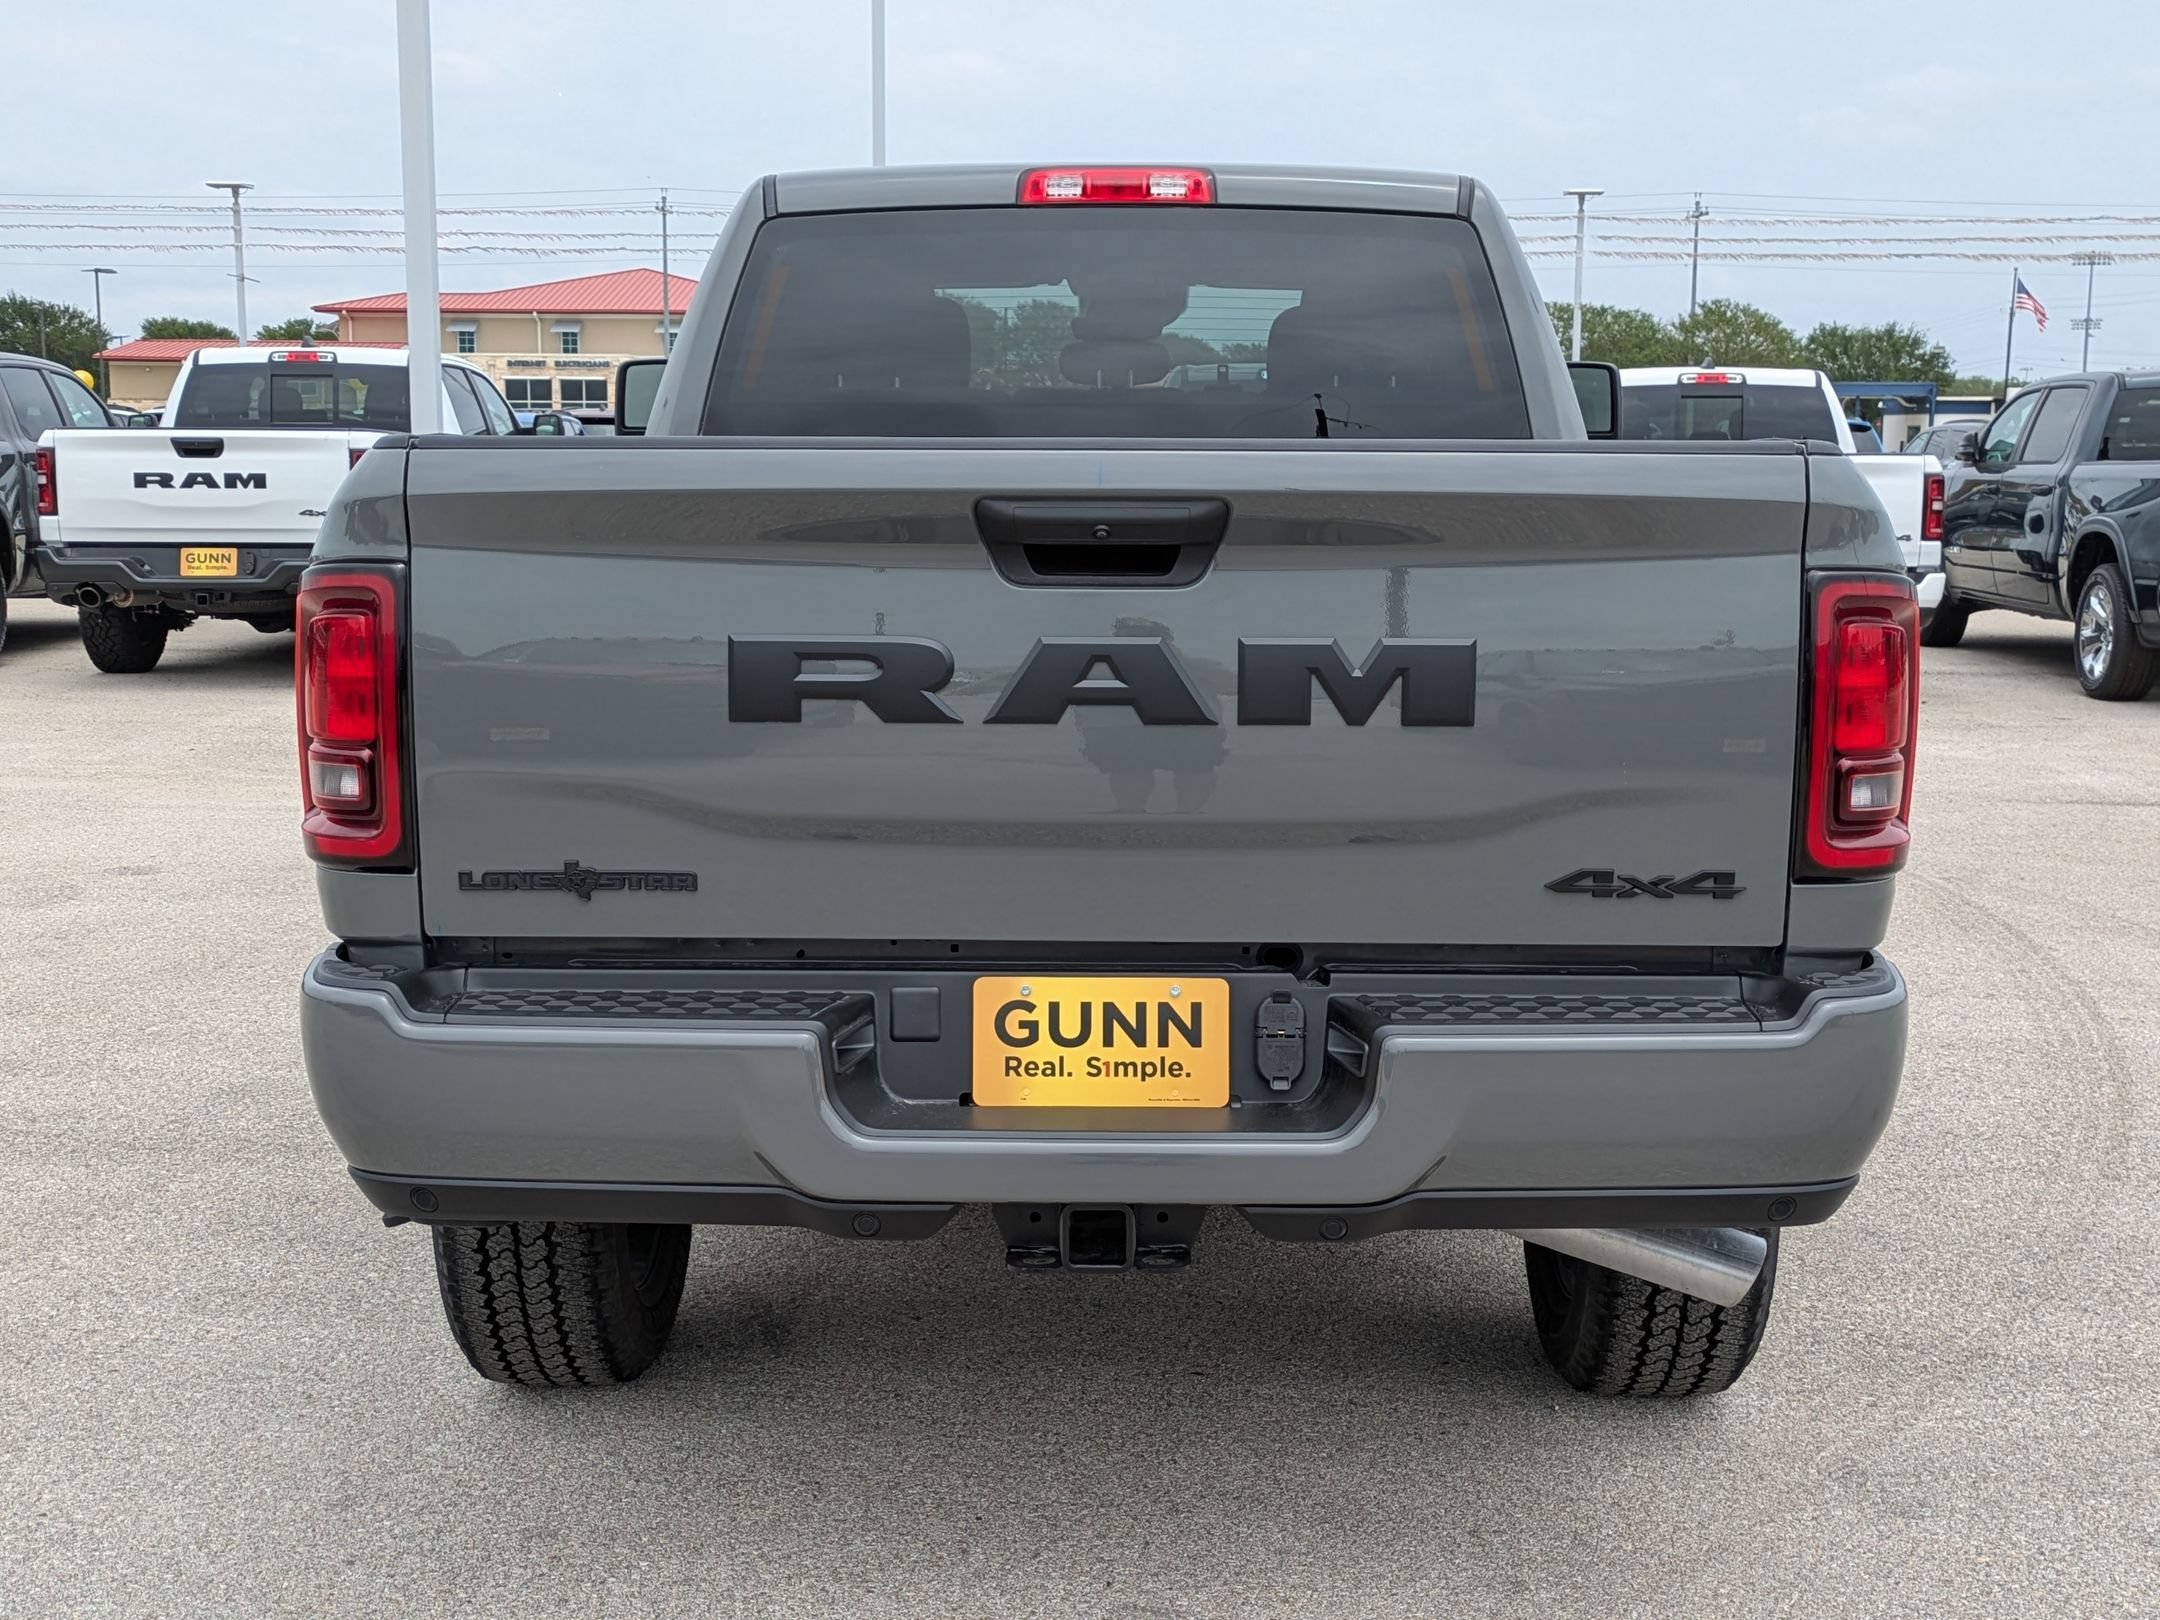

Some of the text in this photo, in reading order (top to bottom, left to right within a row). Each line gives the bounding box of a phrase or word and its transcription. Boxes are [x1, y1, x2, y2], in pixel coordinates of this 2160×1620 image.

[133, 472, 267, 489] RAM
[185, 553, 231, 563] GUNN
[728, 634, 1477, 726] RAM
[457, 870, 698, 892] LONE STAR
[994, 999, 1202, 1049] GUNN
[1004, 1055, 1073, 1078] Real.
